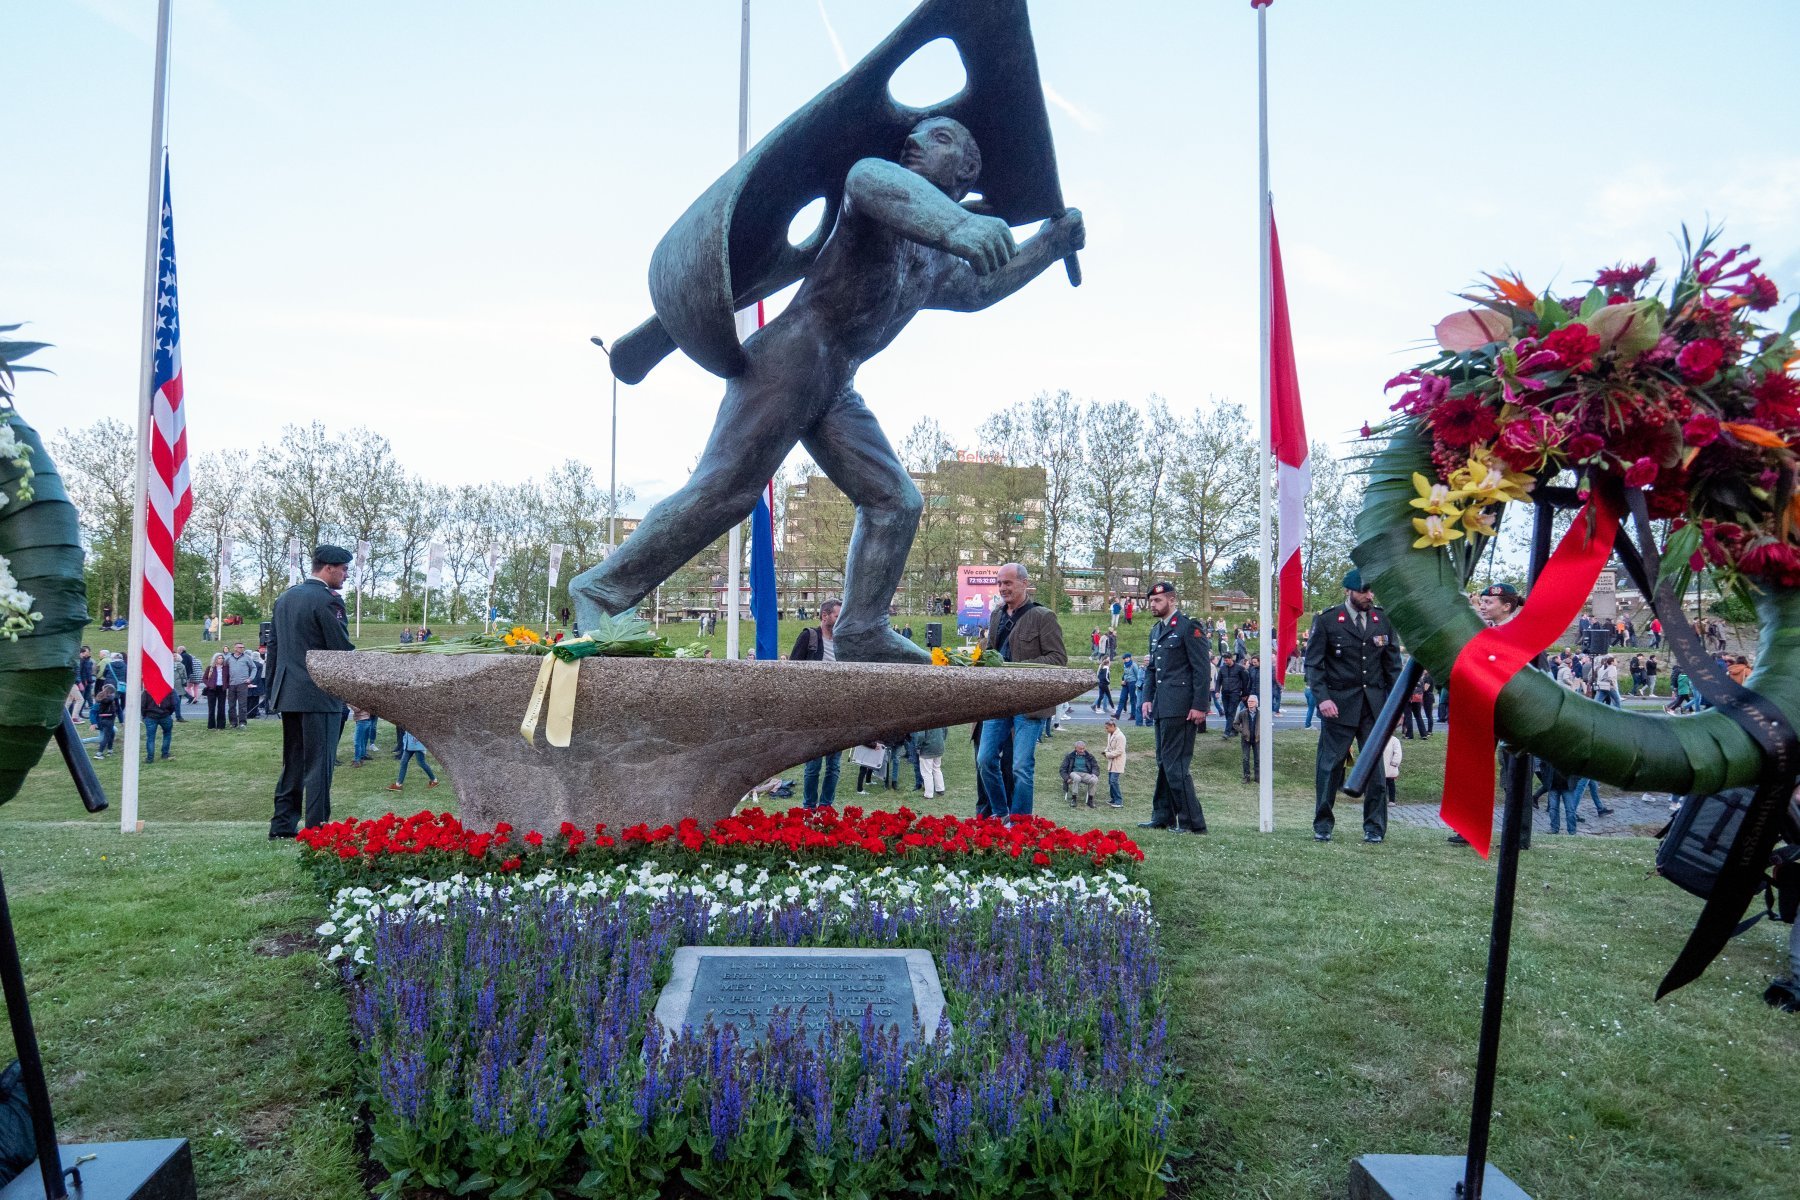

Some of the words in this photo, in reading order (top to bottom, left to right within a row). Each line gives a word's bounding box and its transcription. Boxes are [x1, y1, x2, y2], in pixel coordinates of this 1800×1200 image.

[731, 962, 748, 970] IN
[754, 962, 777, 970] DIT
[784, 962, 875, 970] MONUMENT
[769, 973, 798, 981] WIJ
[802, 973, 854, 981] ALLEN
[858, 974, 886, 982] DIE
[720, 984, 756, 992] MET
[761, 984, 794, 993] JAN
[799, 984, 833, 992] VAN
[706, 995, 727, 1004] IN
[731, 995, 765, 1004] HET
[770, 995, 830, 1004] VERZET
[838, 996, 900, 1006] VIELEN
[716, 1008, 761, 1016] VOOR
